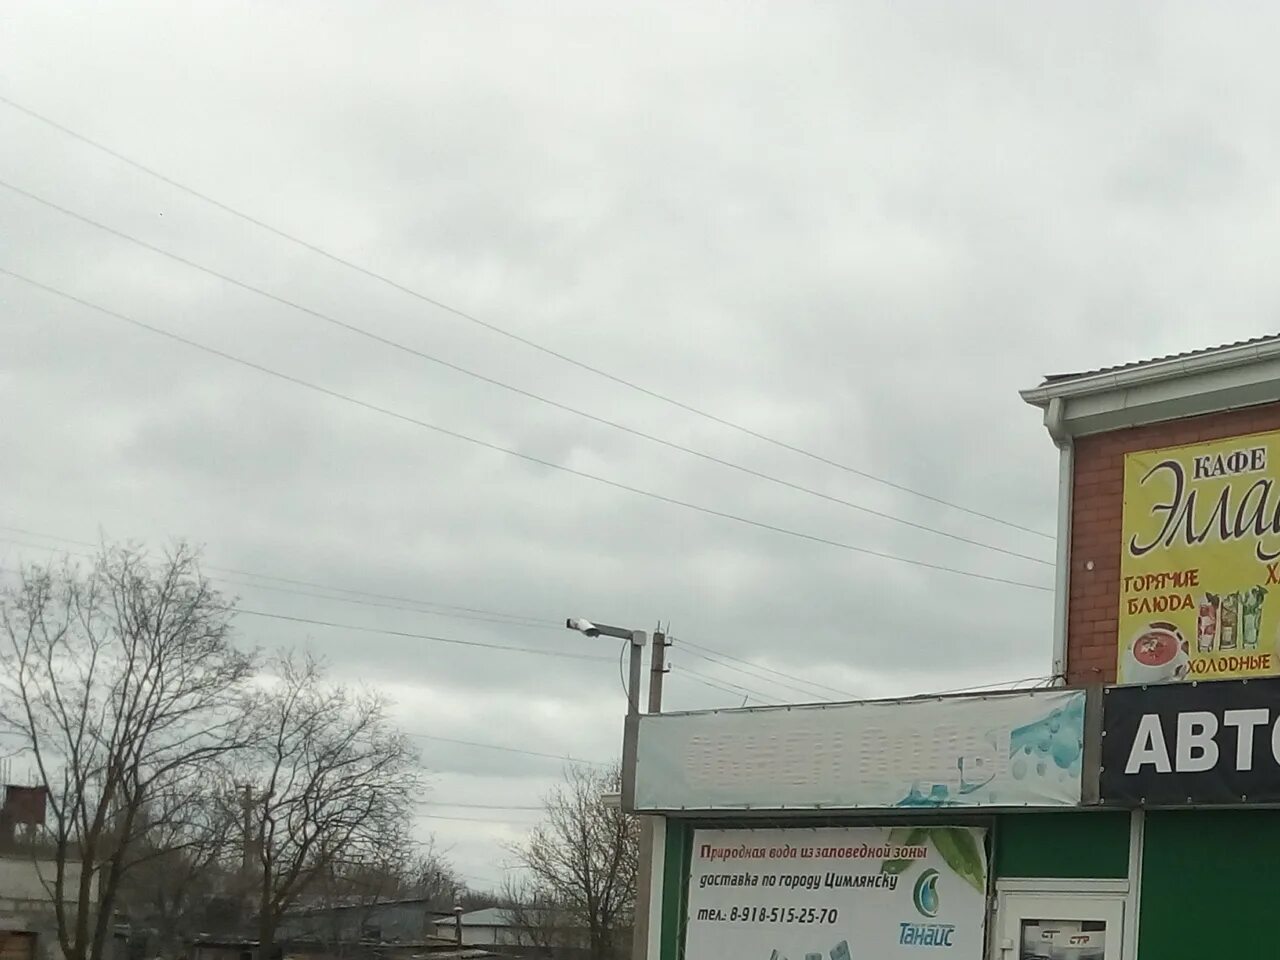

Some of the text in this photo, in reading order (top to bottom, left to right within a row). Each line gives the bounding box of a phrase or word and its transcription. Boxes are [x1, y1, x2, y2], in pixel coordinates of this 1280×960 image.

[1193, 447, 1267, 480] КАФЕ
[1123, 569, 1200, 593] ГОРЯЧИЕ
[1127, 594, 1195, 615] БЛЮДА
[1186, 653, 1272, 676] ХОЛОДНЫЕ
[700, 843, 927, 862] Природная вода из заповедной зоны
[700, 872, 898, 891] доставка по городу Цимлянску
[730, 907, 838, 924] 8-918-515-25-70
[900, 923, 954, 946] Танаис
